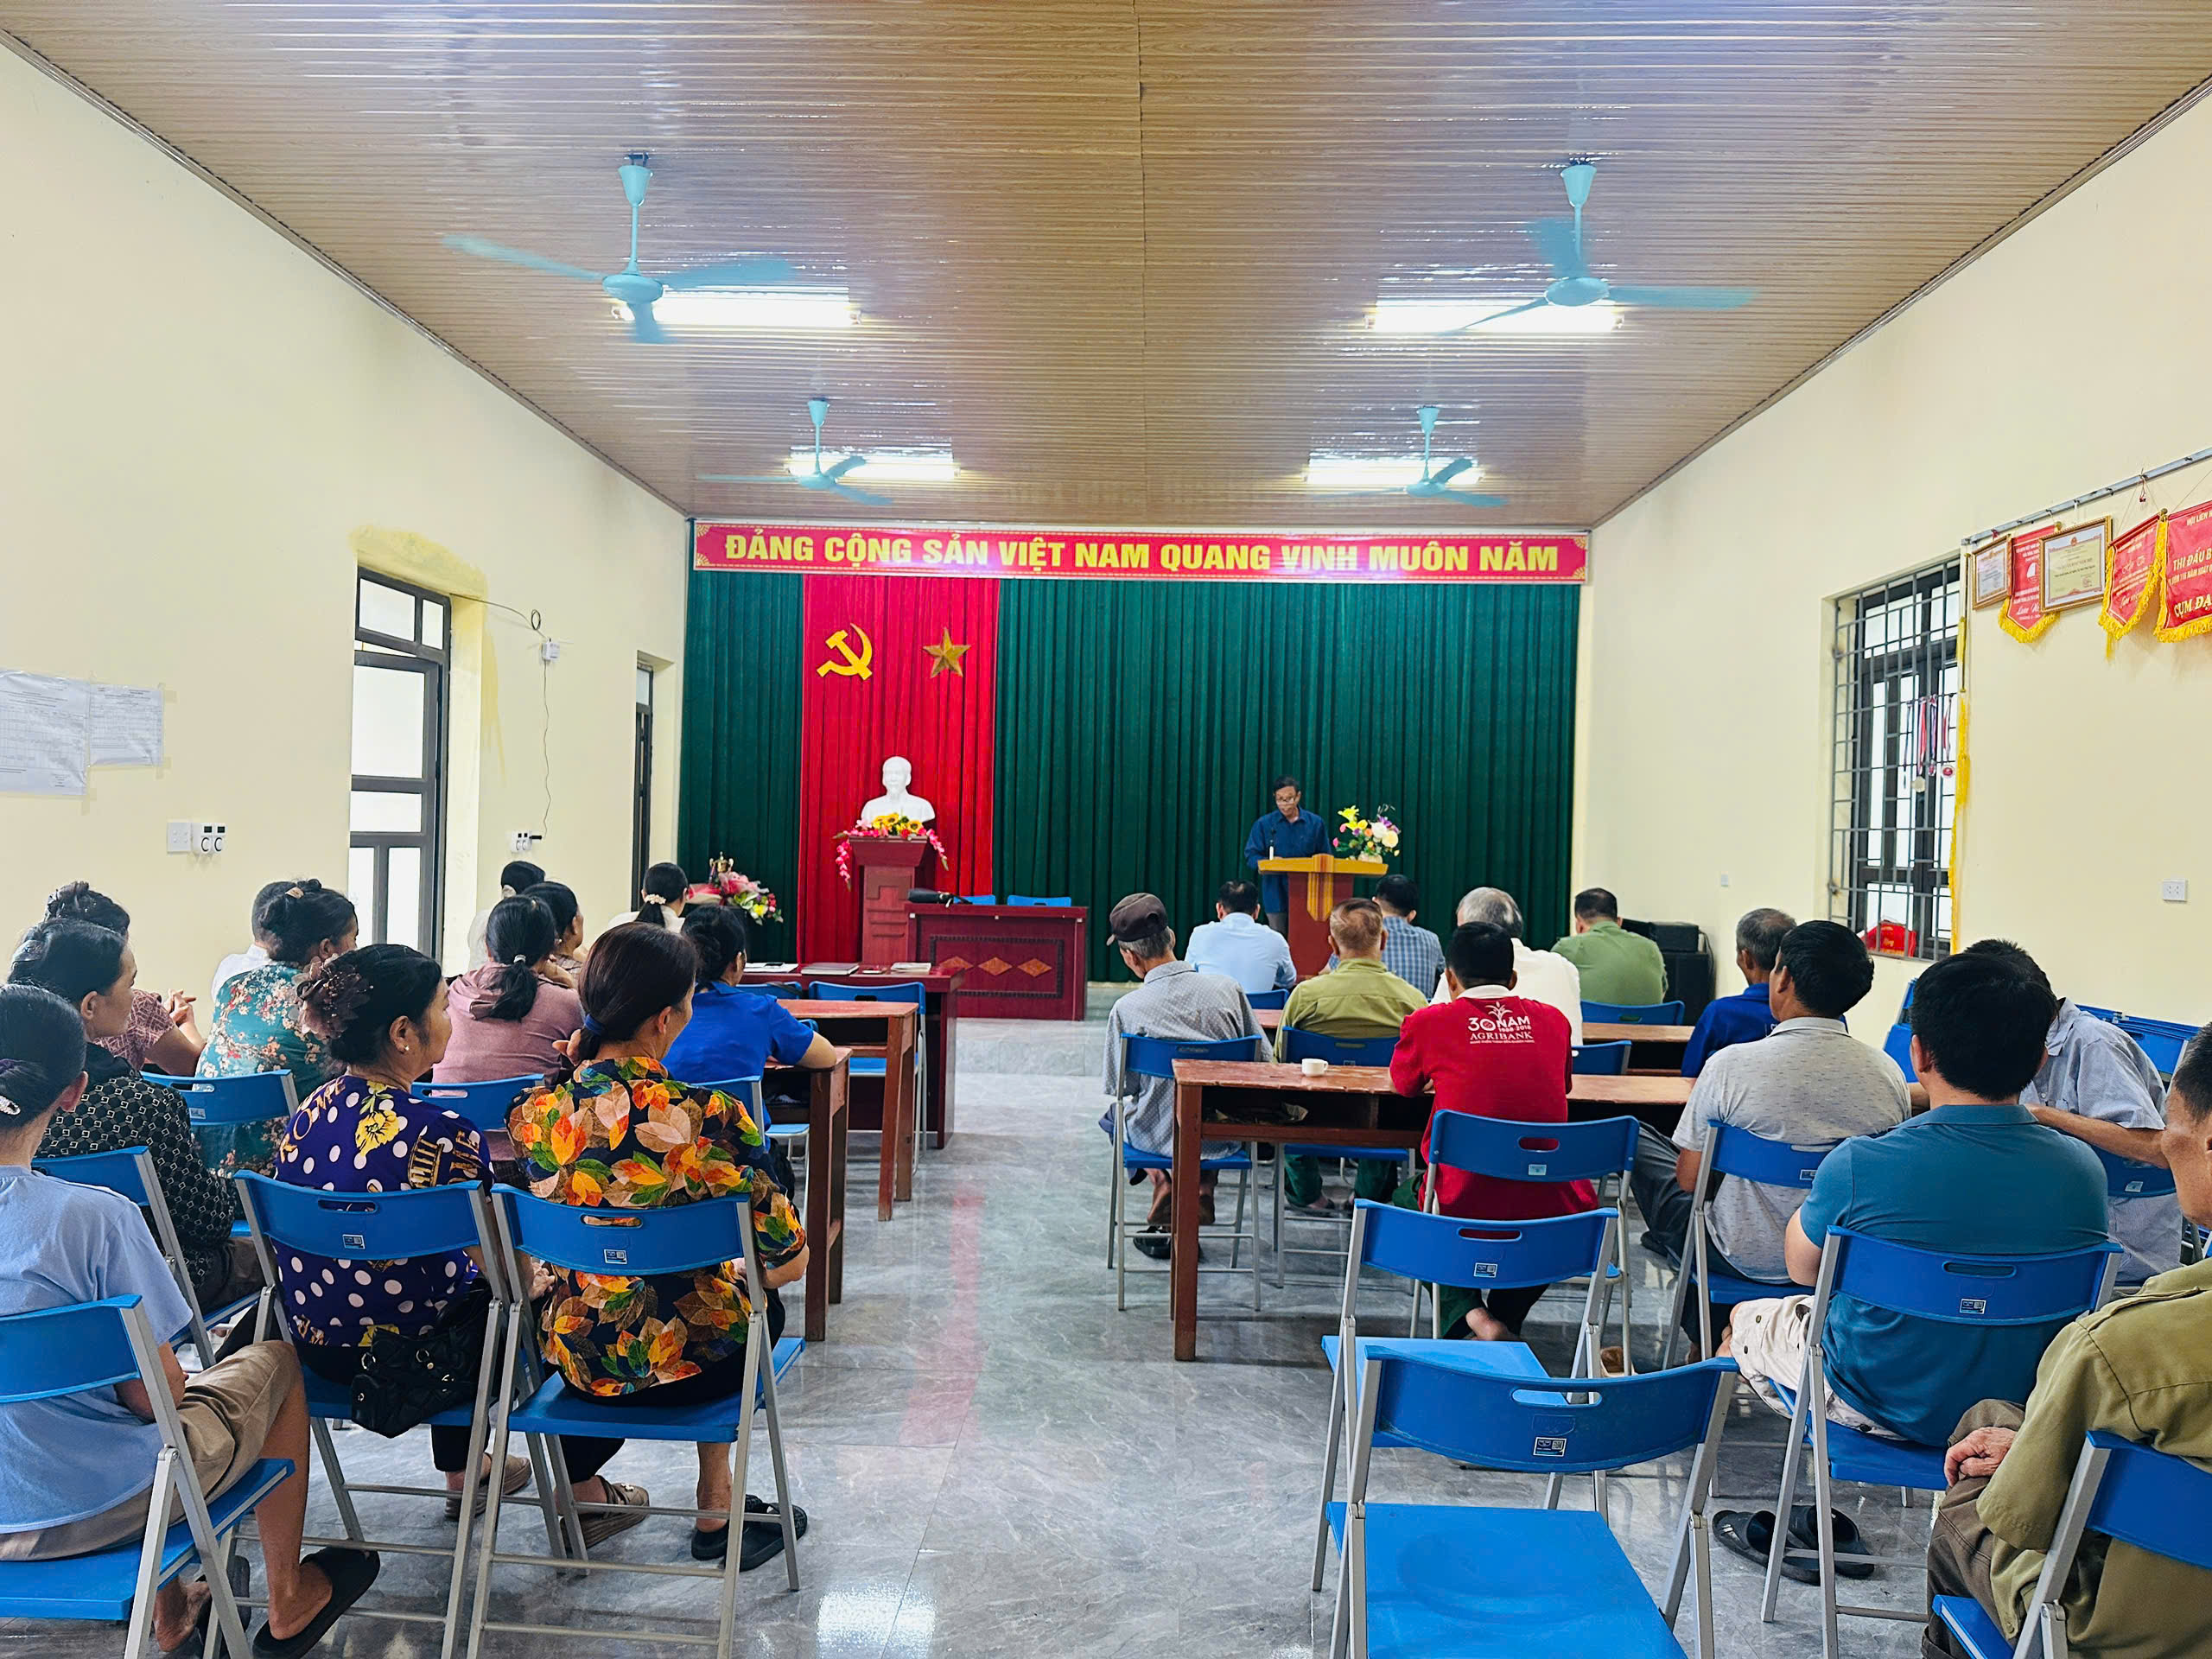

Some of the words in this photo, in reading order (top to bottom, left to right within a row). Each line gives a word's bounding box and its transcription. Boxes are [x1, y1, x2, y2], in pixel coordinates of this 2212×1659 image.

[725, 529, 814, 562] ĐẢNG
[824, 533, 912, 568] CỘNG
[922, 534, 988, 565] SẢN
[999, 537, 1065, 572] VIỆT
[1075, 543, 1149, 569] NAM
[1160, 543, 1271, 572] QUANG
[1281, 544, 1357, 571] VINH
[1369, 541, 1469, 572] MUÔN
[1479, 540, 1558, 571] NĂM
[2174, 599, 2193, 619] CỤM
[1470, 1032, 1534, 1040] AGRIBANK
